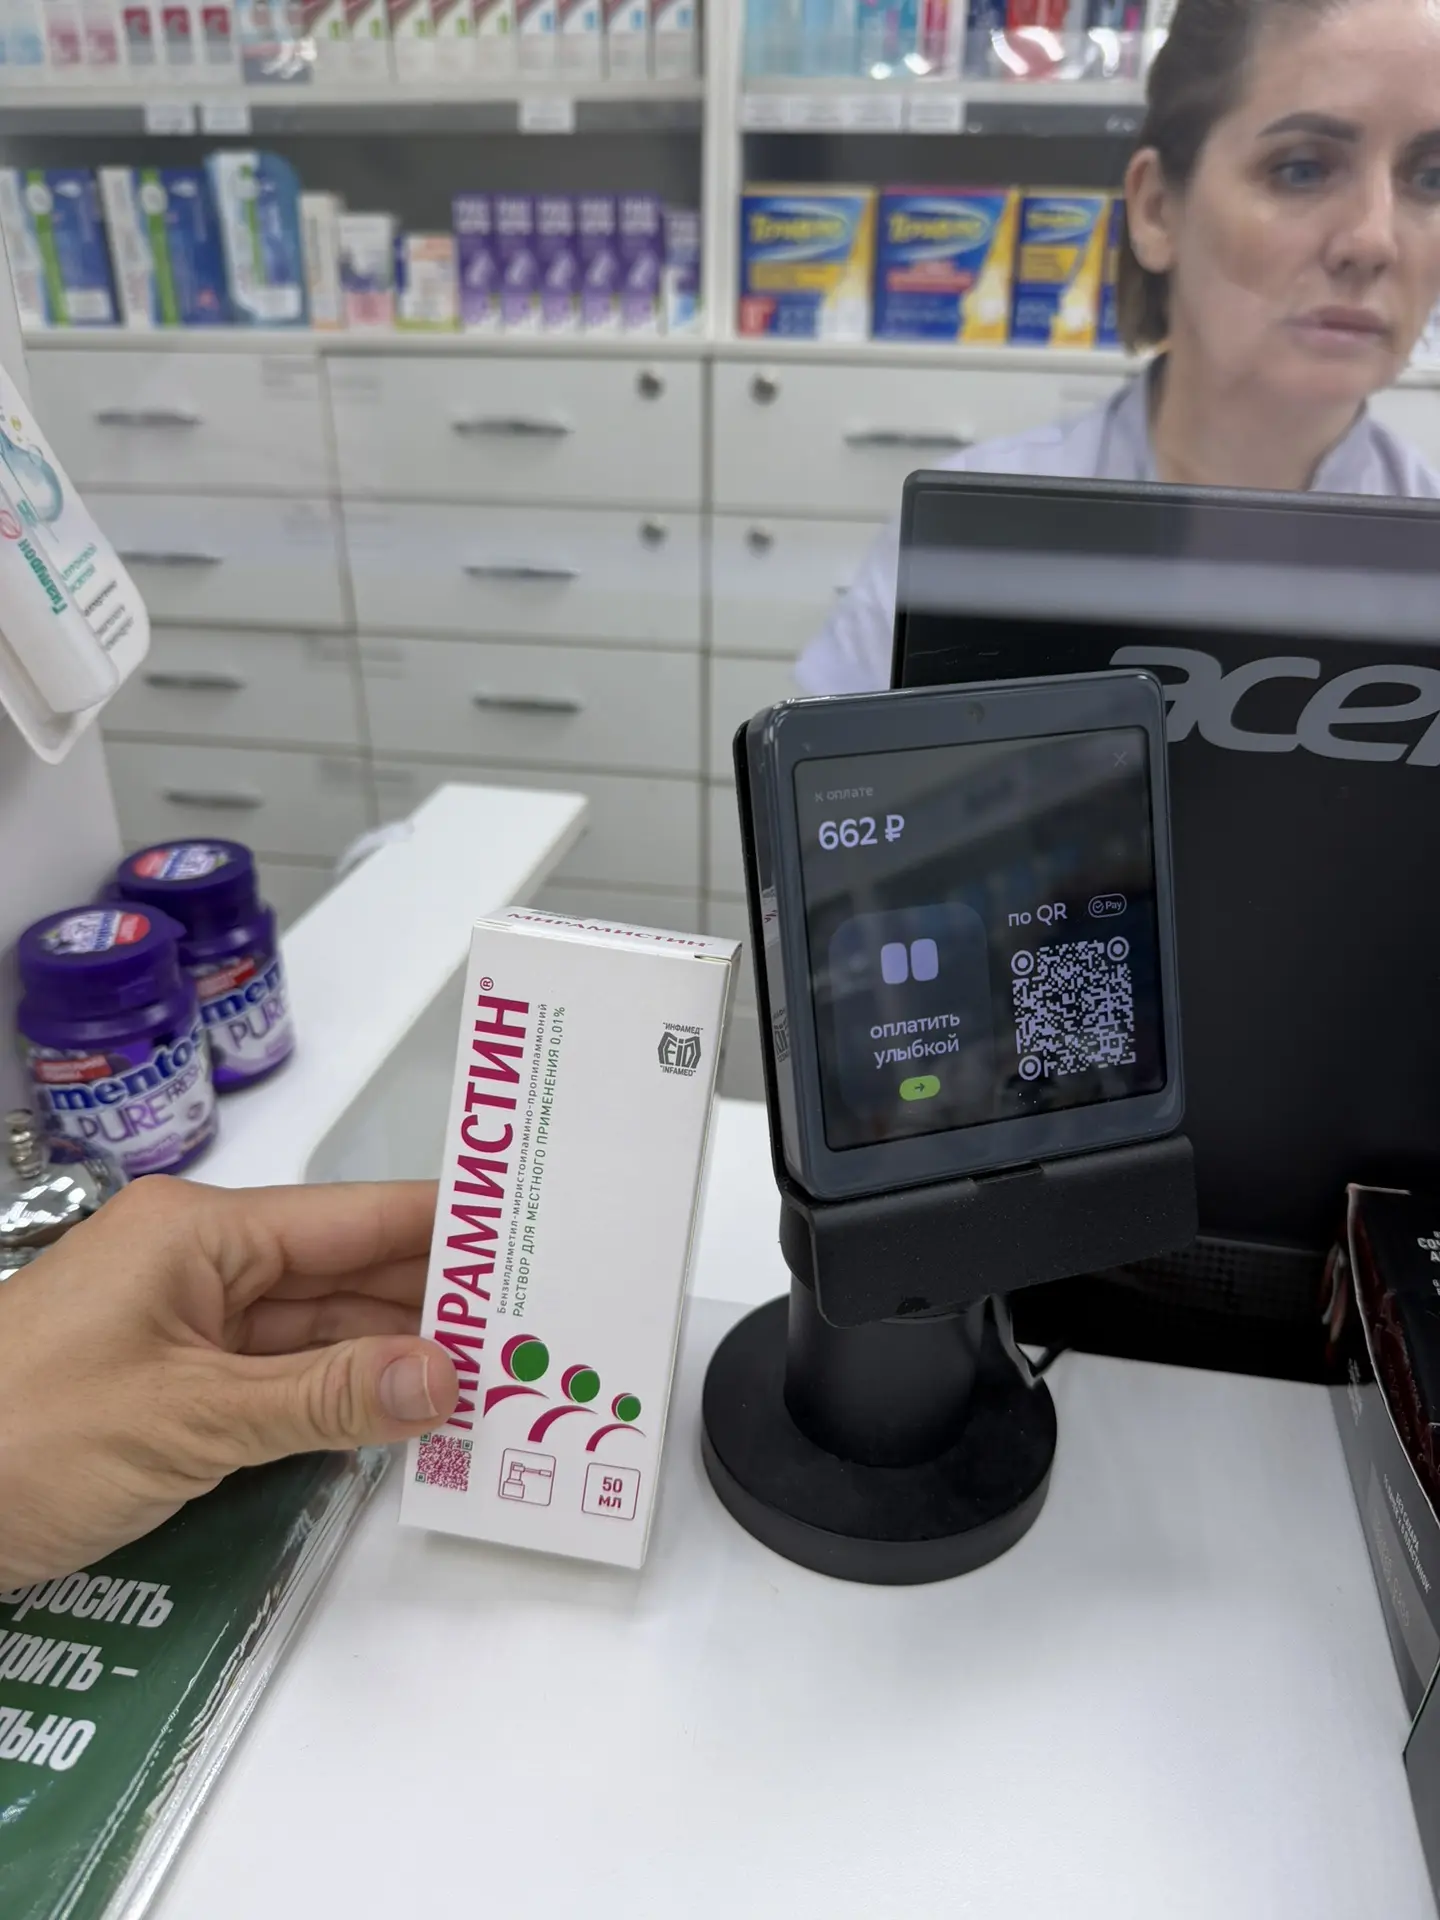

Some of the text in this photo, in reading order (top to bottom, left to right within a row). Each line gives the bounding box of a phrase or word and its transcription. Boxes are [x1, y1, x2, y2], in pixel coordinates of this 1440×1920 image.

[826, 786, 874, 801] оплате
[818, 817, 878, 850] 662
[1008, 902, 1068, 927] по QR
[1104, 900, 1122, 912] Pay
[870, 1012, 960, 1039] оплатить
[874, 1034, 960, 1068] улыбкой
[512, 1006, 566, 1317] РАСТВОР ДЛЯ МЕСТНОГО ПРИМЕНЕНИЯ 0,01%
[602, 1477, 623, 1493] 50
